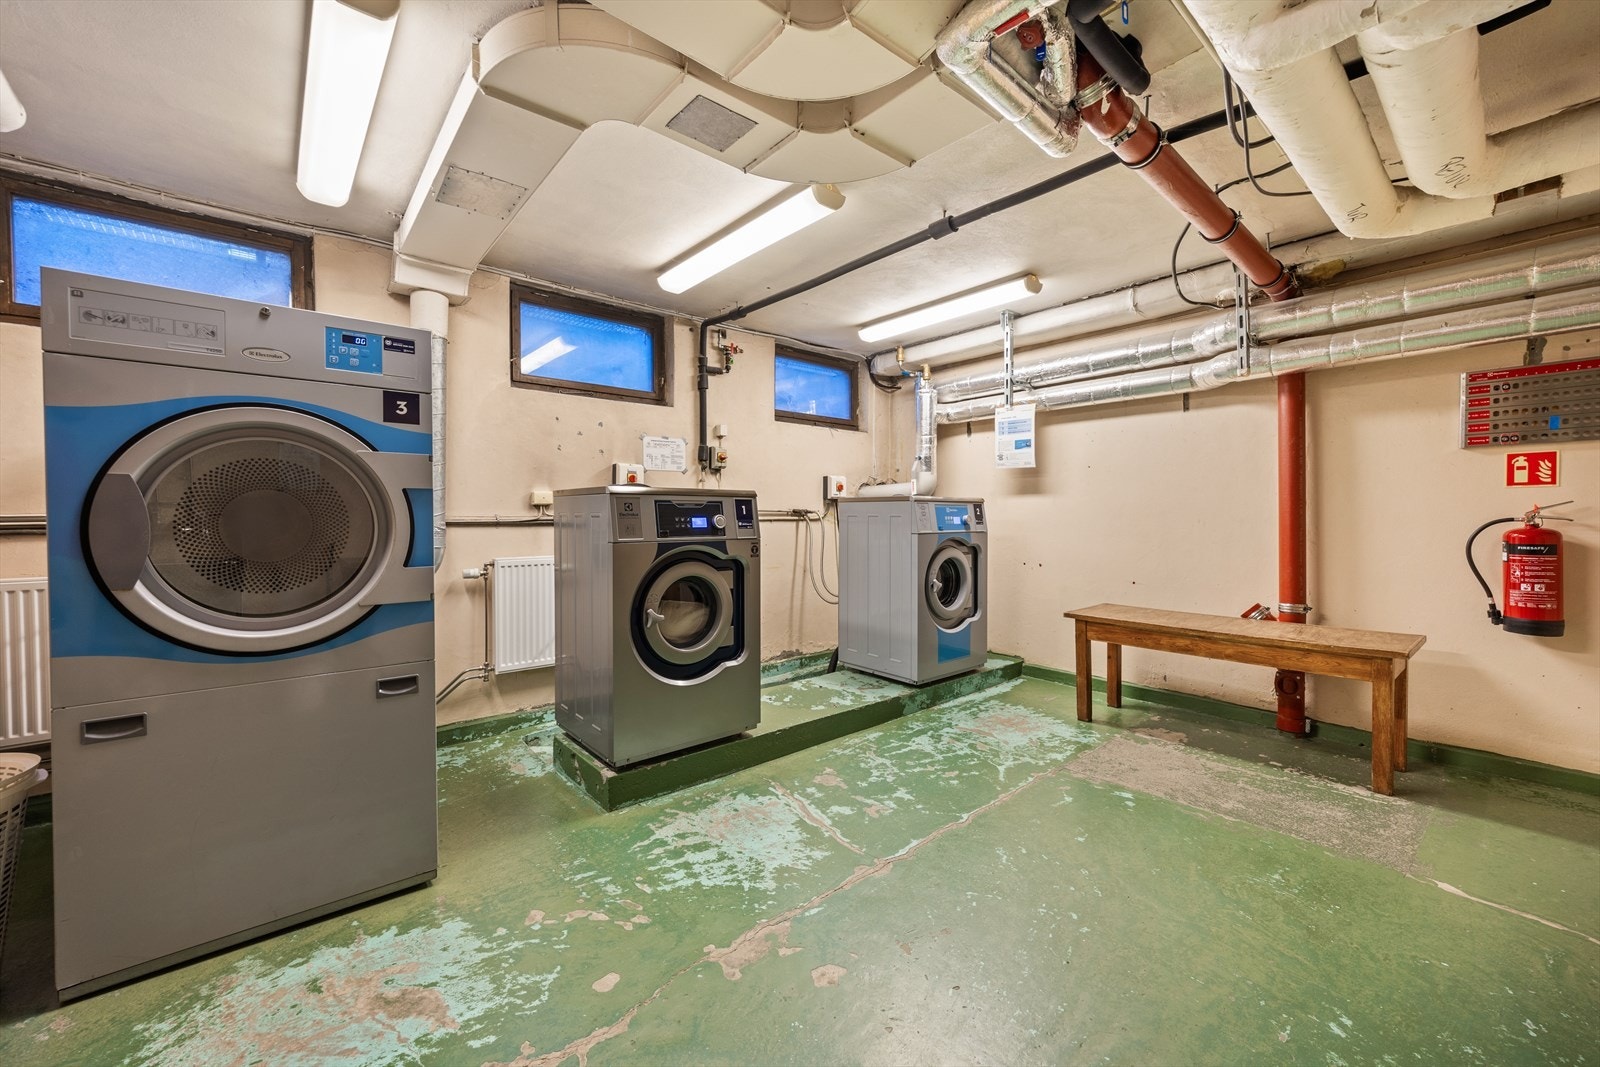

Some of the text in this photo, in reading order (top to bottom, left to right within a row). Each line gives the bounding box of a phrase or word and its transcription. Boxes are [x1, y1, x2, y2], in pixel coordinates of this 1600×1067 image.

[255, 351, 283, 360] Electrolux
[395, 400, 408, 415] 3
[741, 505, 746, 515] 1
